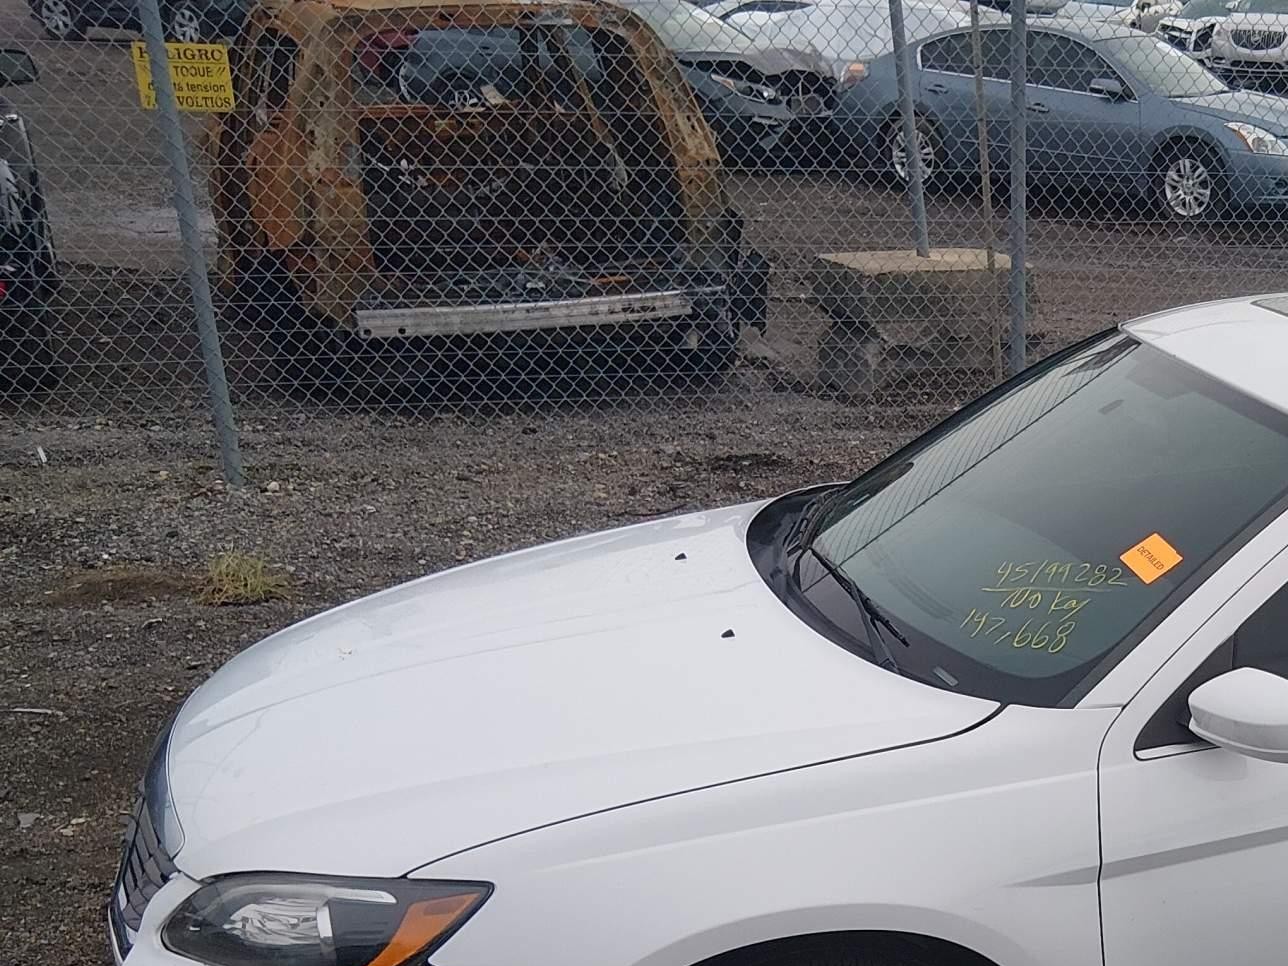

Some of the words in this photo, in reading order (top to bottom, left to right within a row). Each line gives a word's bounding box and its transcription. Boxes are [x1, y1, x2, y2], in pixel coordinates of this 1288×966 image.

[172, 65, 214, 78] TOQUE
[176, 95, 232, 108] VOLTIOS
[1137, 546, 1165, 570] DETAILED
[997, 560, 1128, 587] 45199282
